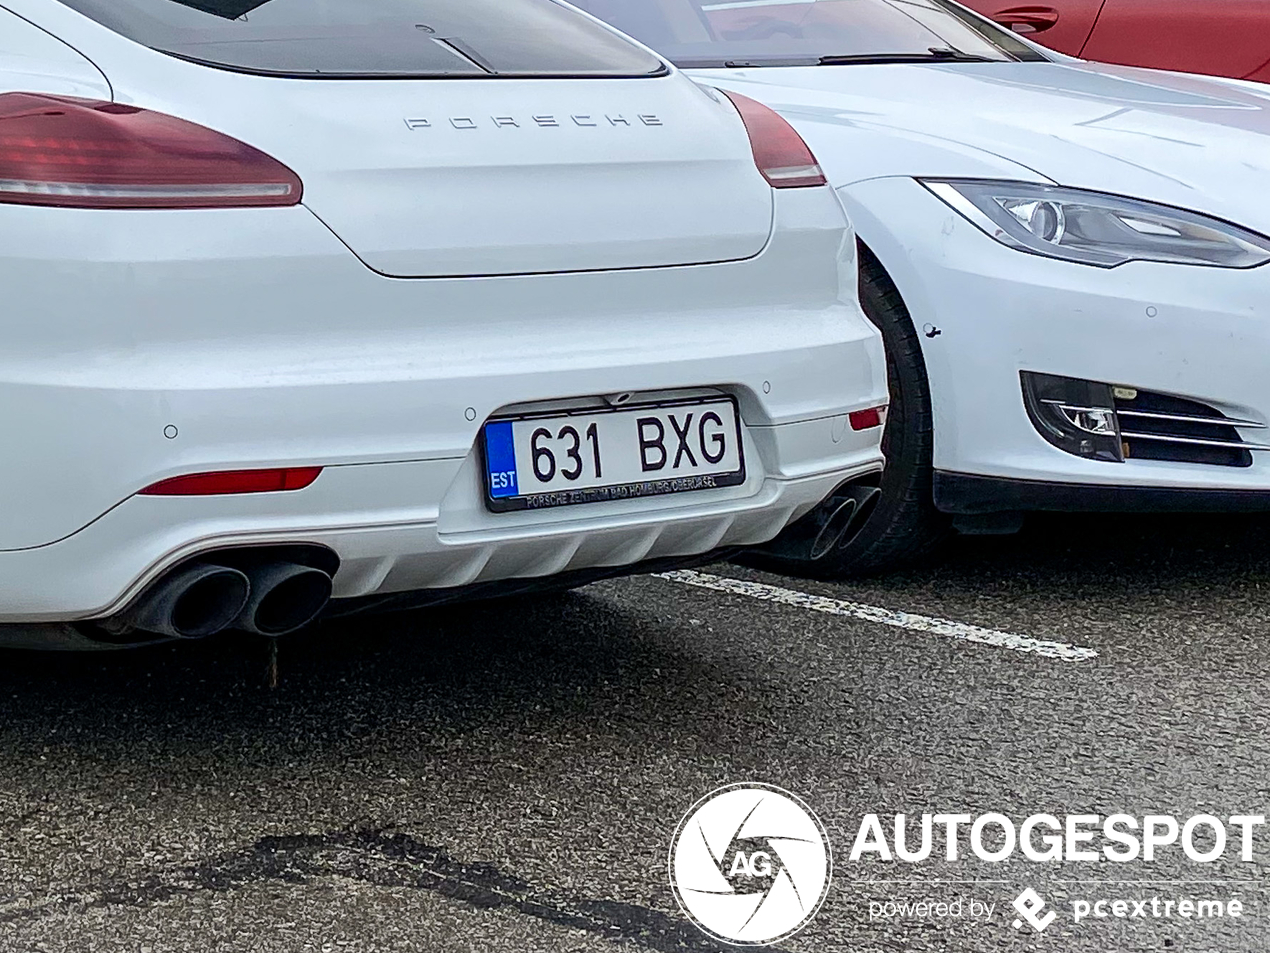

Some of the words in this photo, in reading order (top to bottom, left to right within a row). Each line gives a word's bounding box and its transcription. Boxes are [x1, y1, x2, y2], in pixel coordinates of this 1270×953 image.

[403, 114, 664, 131] PORSCHE
[530, 422, 603, 483] 631
[636, 411, 726, 473] BXG
[491, 470, 516, 489] EST
[527, 493, 568, 508] PORSCHE
[610, 485, 628, 498] BAD
